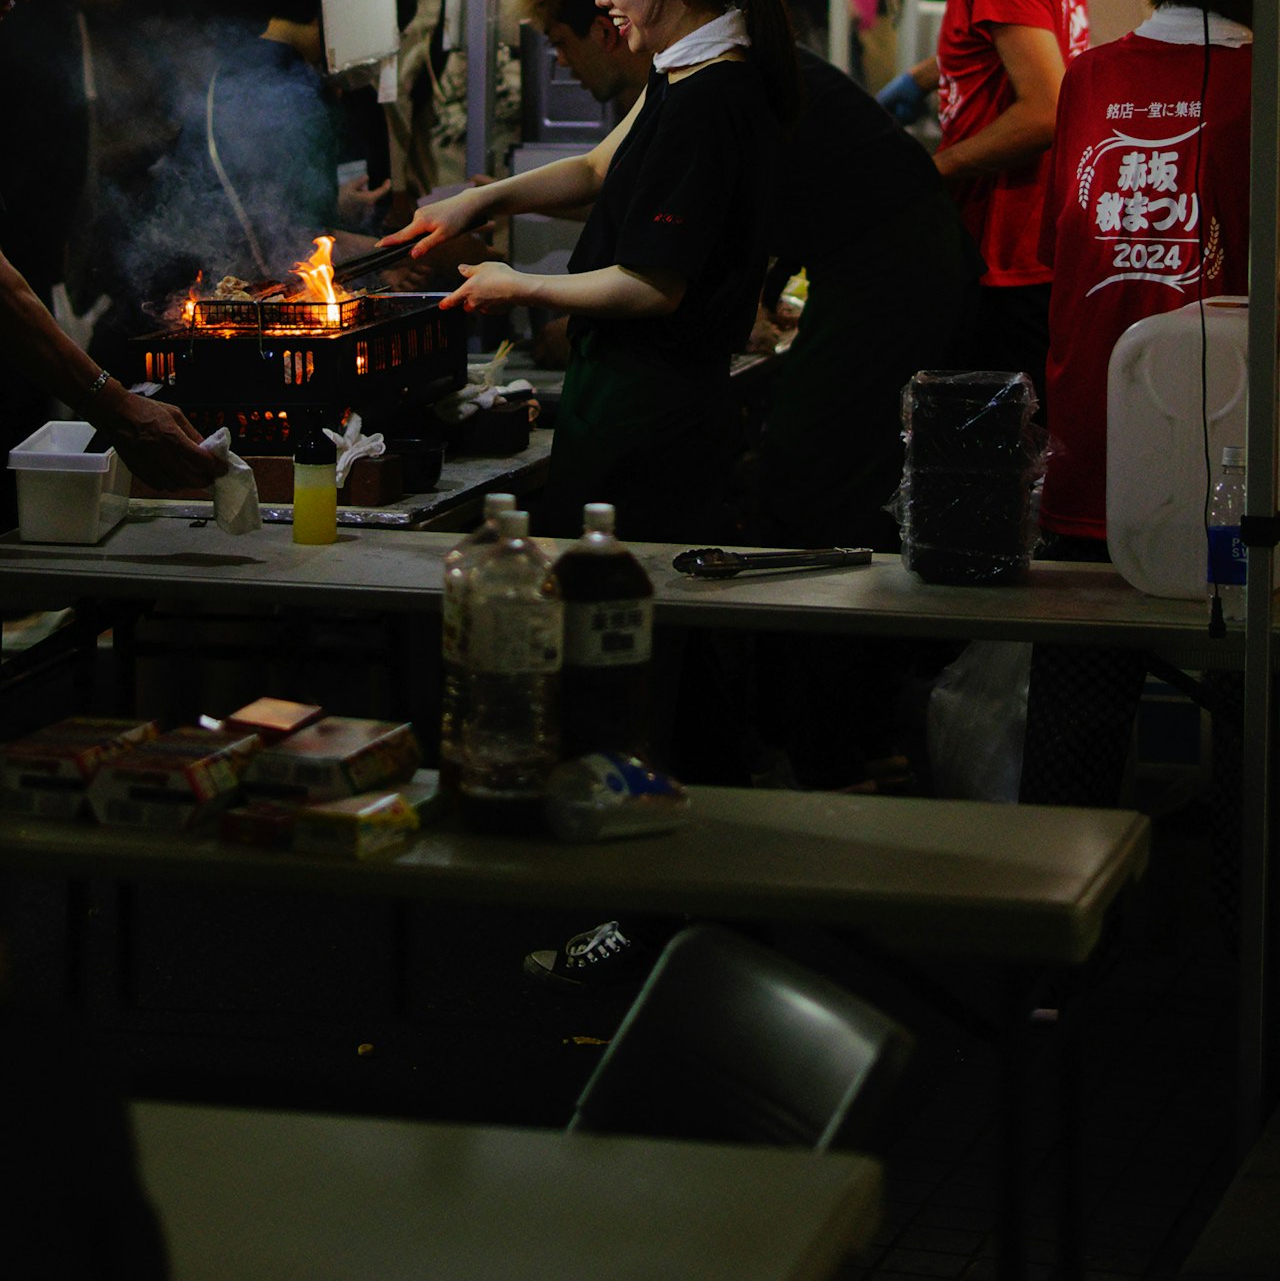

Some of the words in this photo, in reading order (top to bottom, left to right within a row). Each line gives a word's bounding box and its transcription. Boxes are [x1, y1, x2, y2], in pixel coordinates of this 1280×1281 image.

[1106, 101, 1203, 120] 銘店一堂に集結
[1117, 150, 1180, 193] 赤坂
[1094, 192, 1200, 233] 秋まつり
[1112, 243, 1182, 270] 2024
